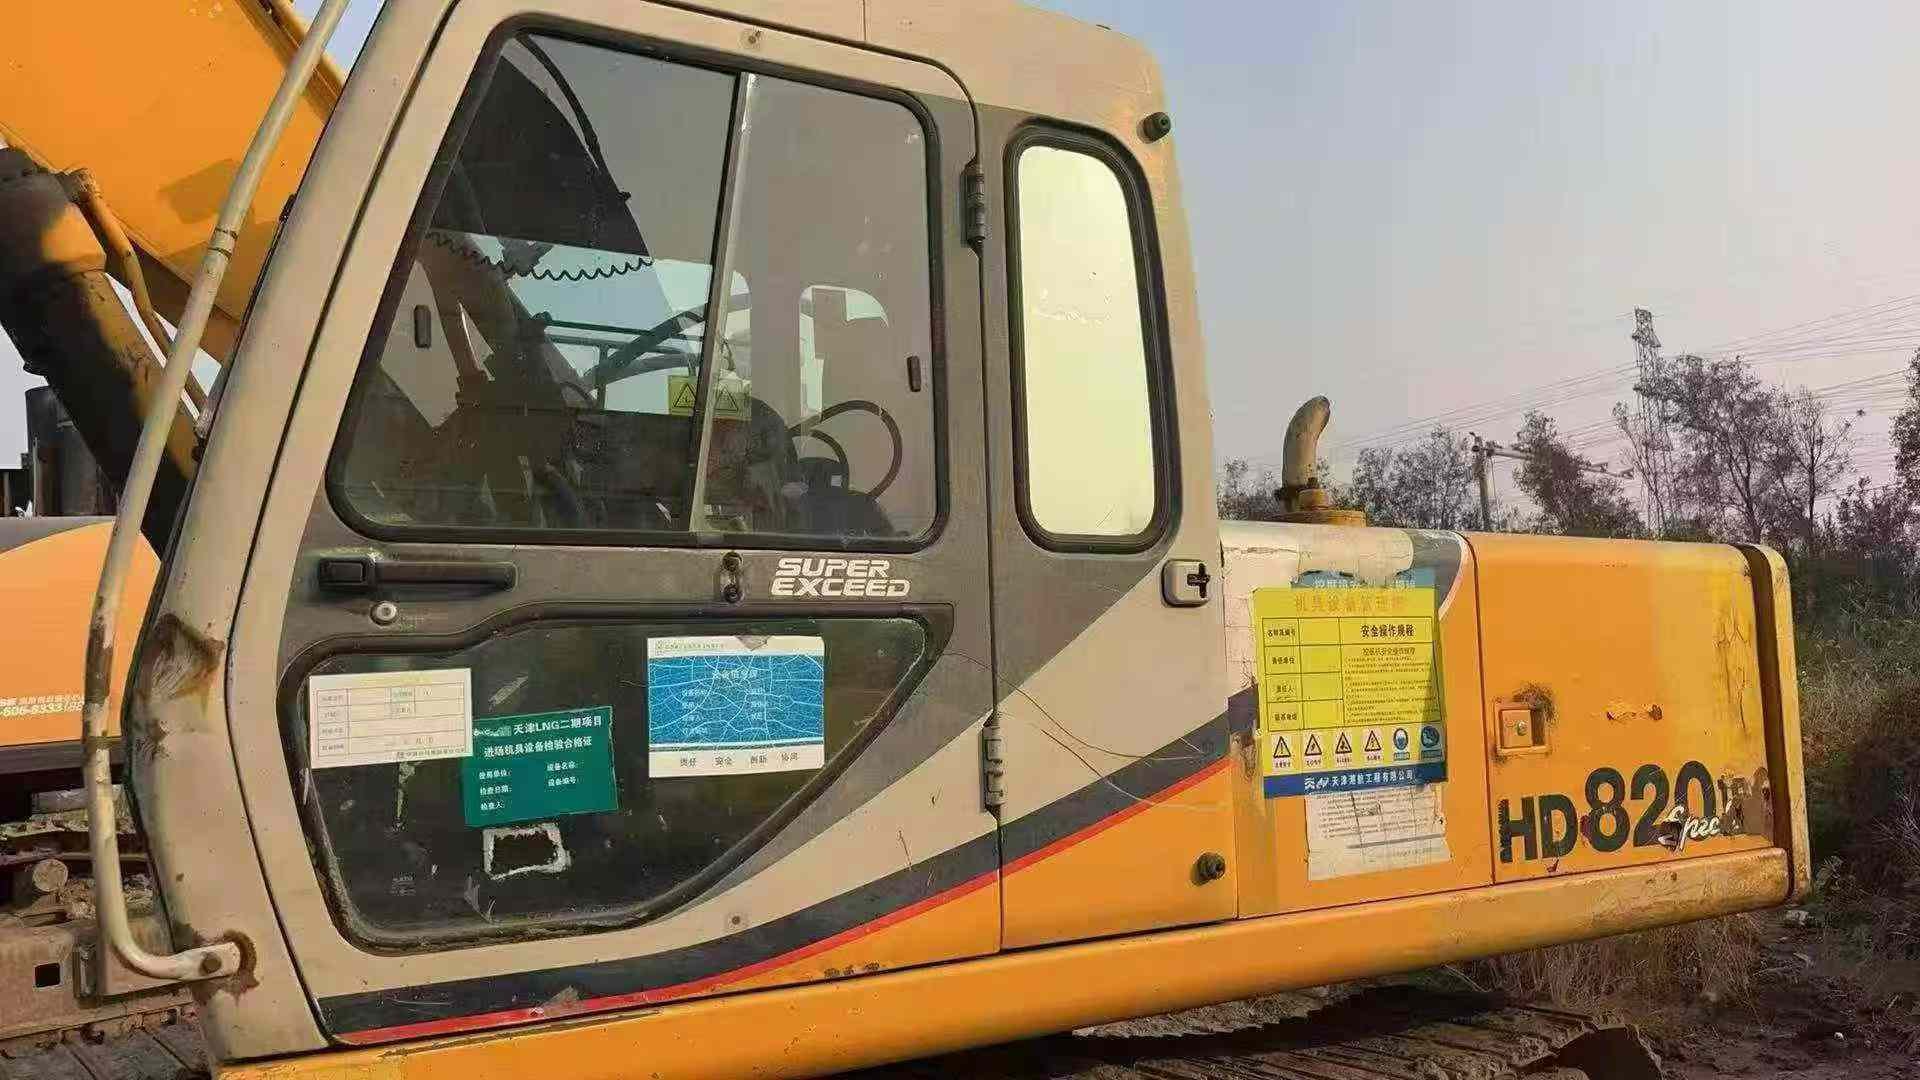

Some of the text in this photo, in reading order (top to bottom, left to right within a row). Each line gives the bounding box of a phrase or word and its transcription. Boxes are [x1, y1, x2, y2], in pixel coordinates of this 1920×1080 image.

[776, 558, 889, 577] SUPER
[771, 578, 910, 597] EXCEED
[1360, 624, 1415, 638] 安全操作规程
[514, 716, 601, 735] 天津LNG二期项目
[484, 736, 593, 758] 进场机具设备检验合格证
